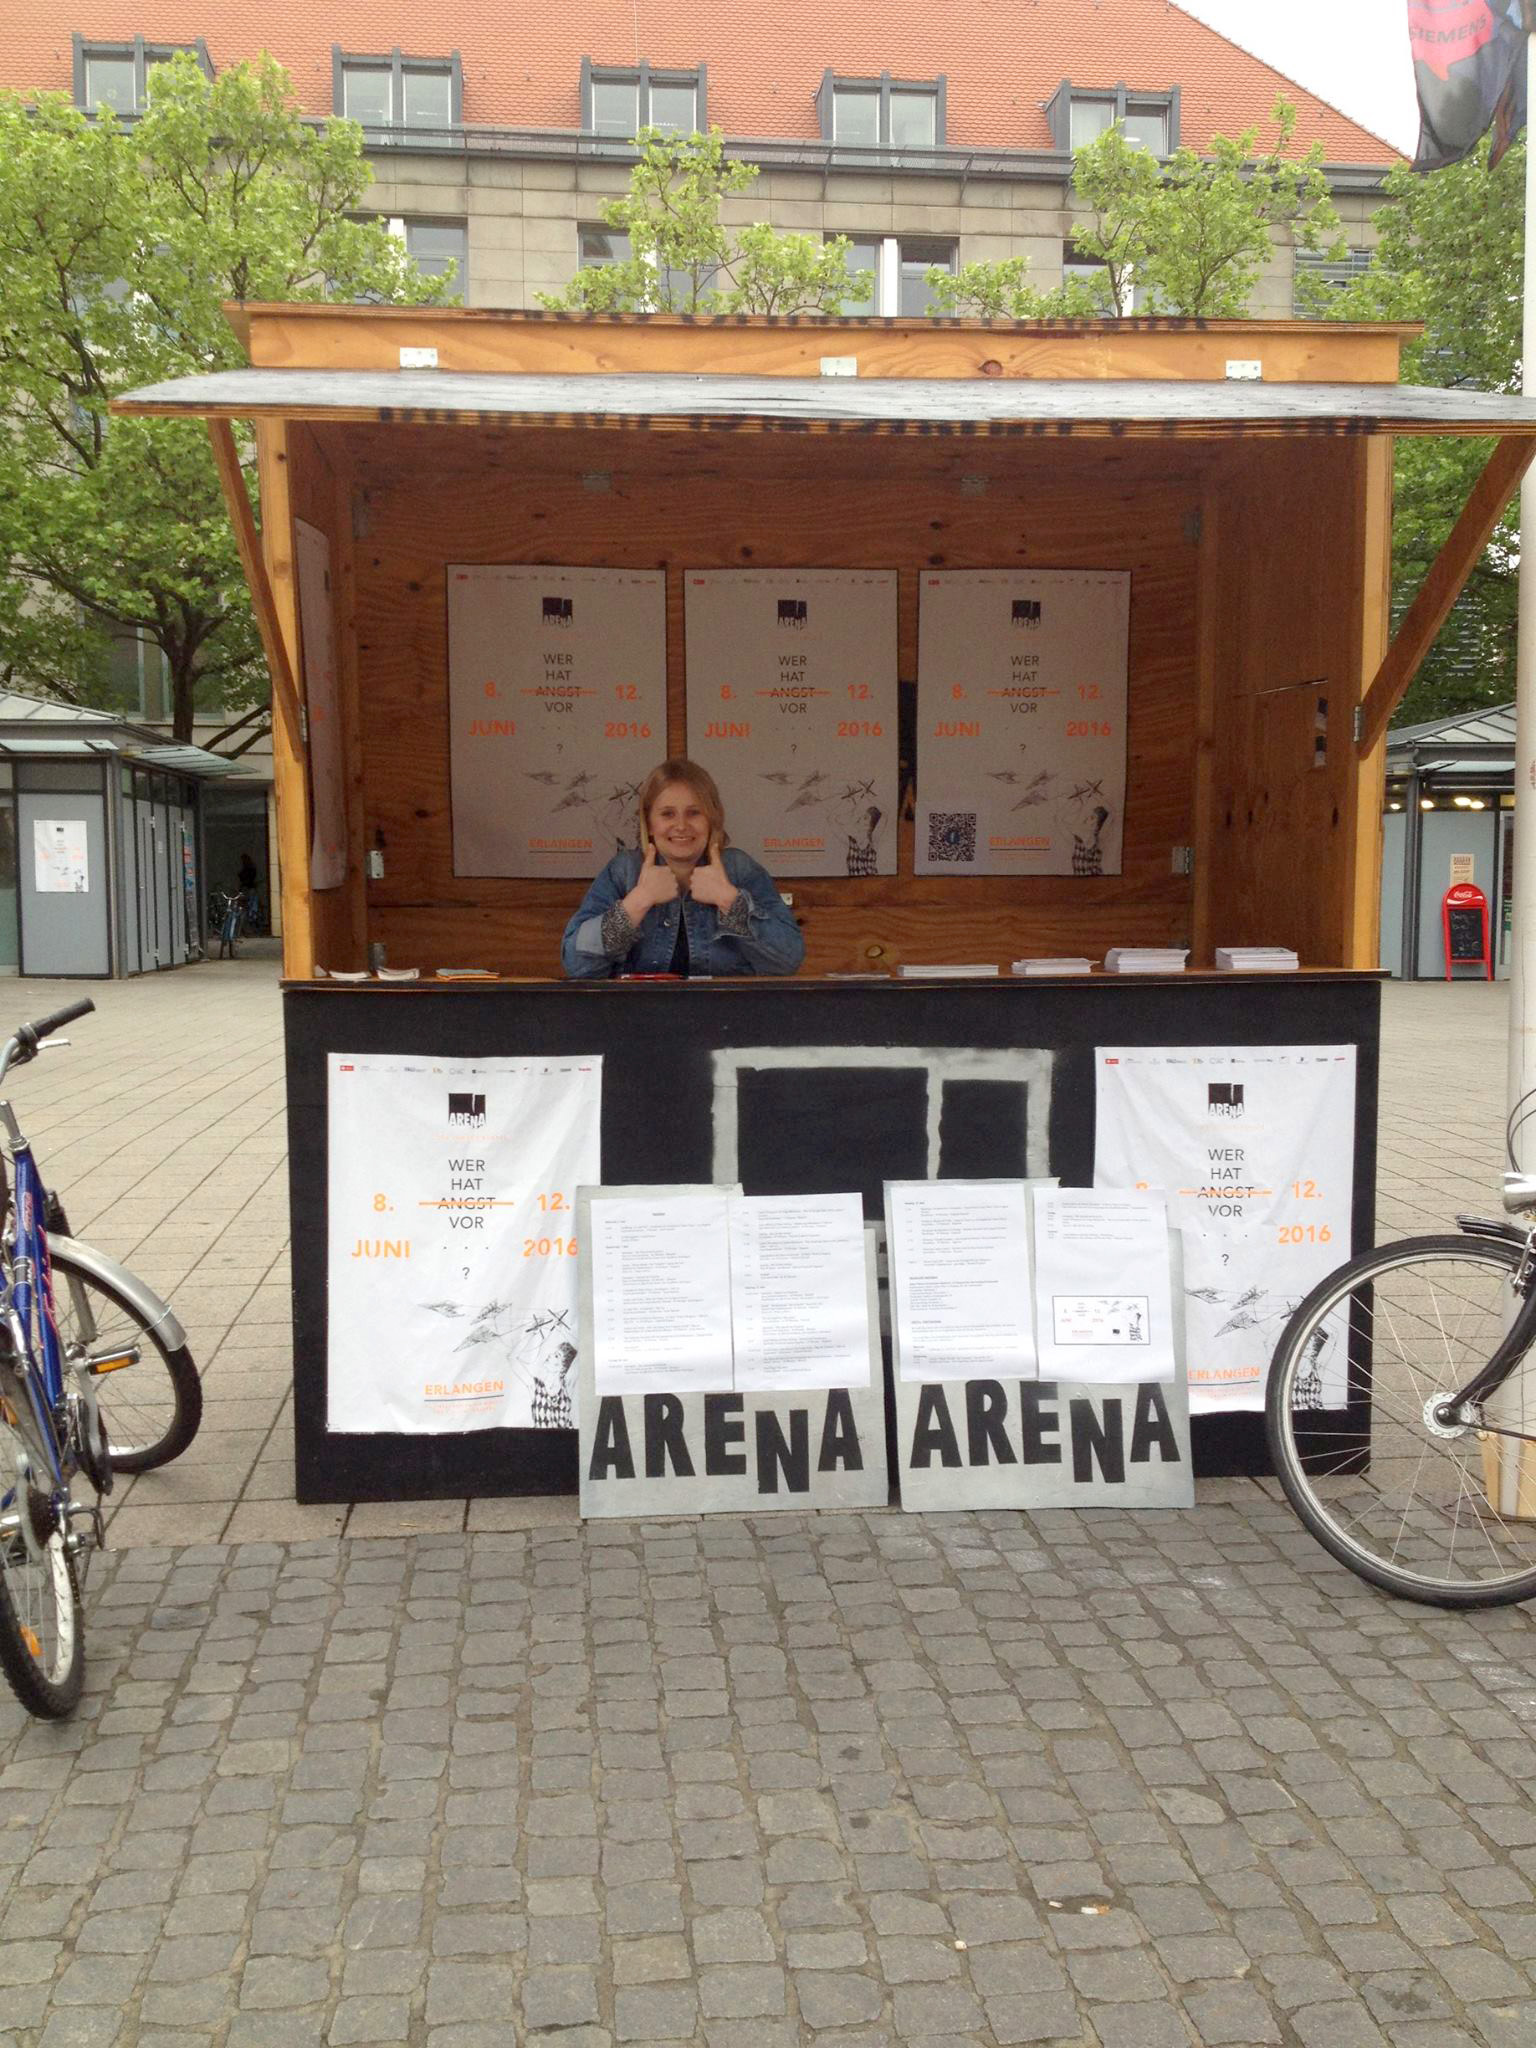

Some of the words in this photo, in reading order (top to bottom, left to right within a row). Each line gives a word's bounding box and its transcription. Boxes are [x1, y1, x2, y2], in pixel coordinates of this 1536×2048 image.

[543, 654, 574, 665] WER
[777, 656, 808, 666] WER
[1010, 656, 1040, 666] WER
[545, 671, 572, 680] HAT
[780, 671, 806, 682] HAT
[1012, 671, 1038, 681] HAT
[485, 683, 503, 698] 8.
[536, 687, 581, 697] ANGST
[613, 683, 643, 700] 12.
[720, 684, 738, 699] 8.
[771, 688, 815, 697] ANGST
[847, 684, 874, 699] 12.
[951, 684, 969, 699] 8.
[1002, 688, 1046, 697] ANGST
[1077, 684, 1104, 699] 12.
[544, 702, 573, 713] VOR
[779, 703, 808, 713] VOR
[1010, 703, 1038, 713] VOR
[469, 721, 515, 736] JUNI
[605, 722, 652, 738] 2016
[705, 722, 750, 737] JUNI
[838, 722, 882, 736] 2016
[934, 722, 980, 737] JUNI
[1067, 722, 1111, 736] 2016
[1209, 1103, 1244, 1119] ARENA
[449, 1113, 486, 1128] ARENA
[1207, 1149, 1245, 1161] WER
[448, 1160, 486, 1172] WER
[1210, 1168, 1241, 1179] HAT
[450, 1179, 483, 1190] HAT
[1291, 1181, 1323, 1198] 12.
[1198, 1187, 1254, 1198] ANGST
[373, 1192, 395, 1212] 8.
[438, 1197, 494, 1209] ANGST
[536, 1192, 571, 1212] 12.
[1208, 1205, 1243, 1217] VOR
[449, 1217, 484, 1229] VOR
[1279, 1227, 1331, 1244] 2016
[352, 1240, 410, 1259] JUNI
[523, 1239, 578, 1257] 2016
[425, 1380, 504, 1395] ERLANGEN
[909, 1379, 1181, 1483] ARENA
[588, 1388, 864, 1494] ARENA
